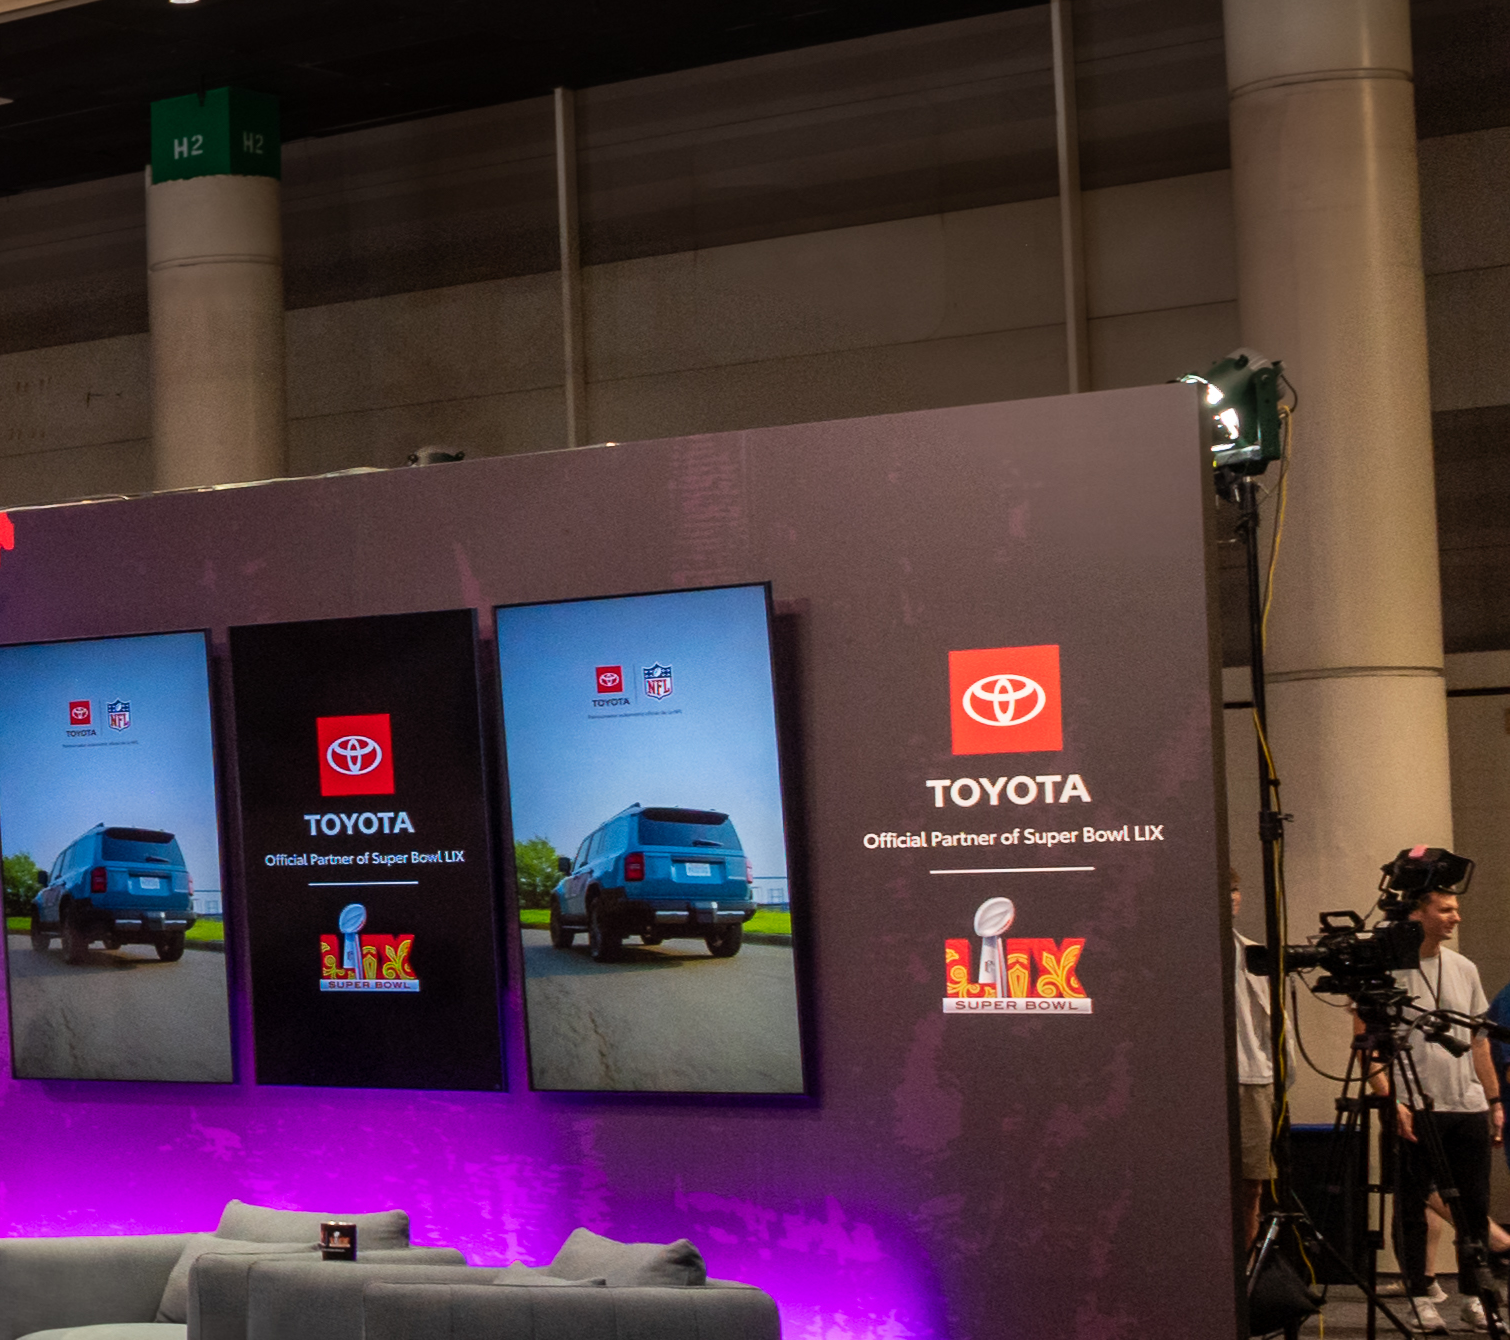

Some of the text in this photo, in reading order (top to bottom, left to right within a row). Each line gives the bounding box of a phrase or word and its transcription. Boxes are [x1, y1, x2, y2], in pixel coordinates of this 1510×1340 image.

[173, 134, 204, 160] H2
[242, 132, 264, 155] H2
[647, 678, 670, 695] NFL
[592, 698, 630, 707] TOYOTA
[110, 713, 130, 728] NFL
[66, 729, 97, 737] TOYOTA
[926, 774, 1092, 807] TOYOTA
[304, 812, 415, 835] TOYOTA
[863, 825, 1165, 849] Official Partner of Super Bowl LIX
[265, 850, 465, 866] Official Partner of Super Bowl LIX
[328, 980, 410, 989] SUPER BOWL
[955, 1000, 1080, 1011] SUPER BOWL
